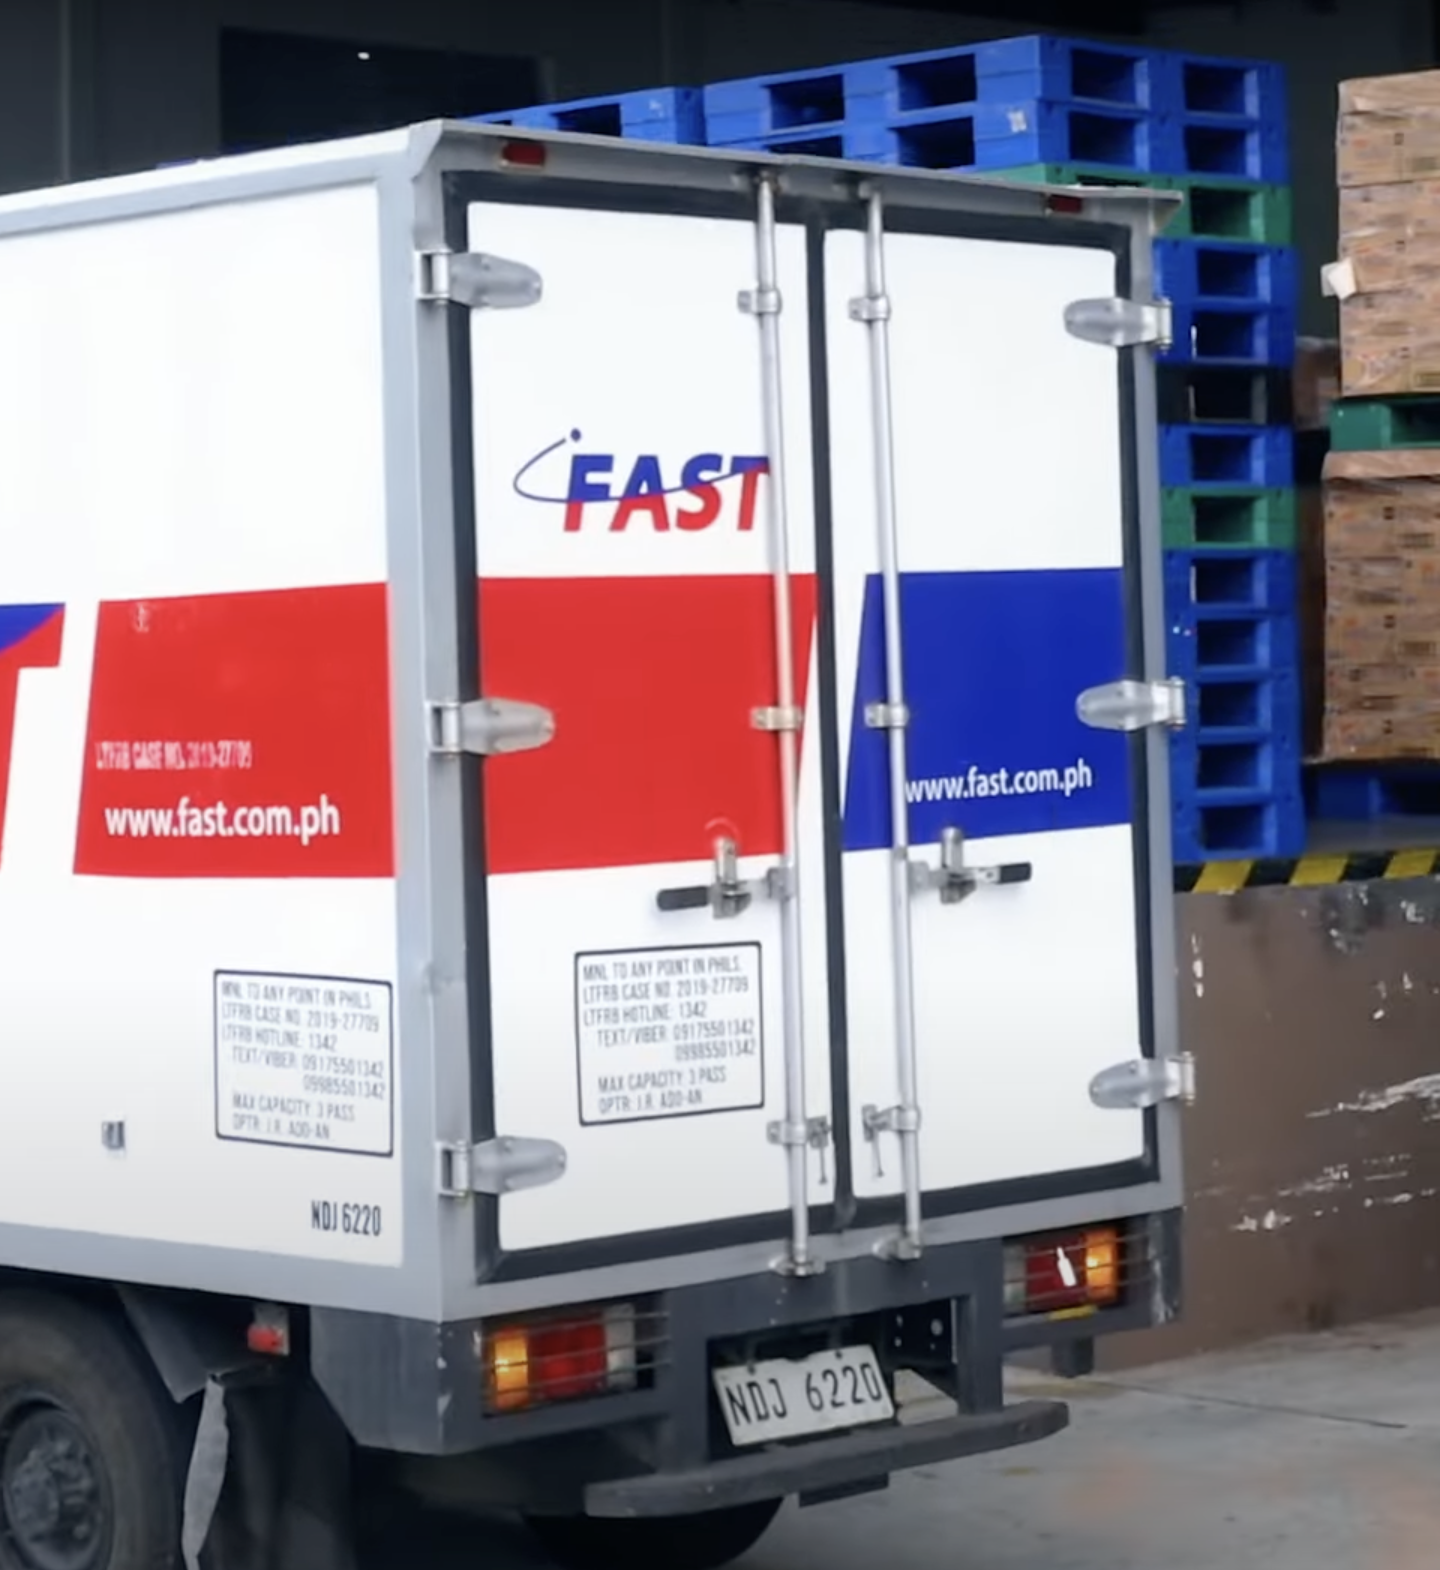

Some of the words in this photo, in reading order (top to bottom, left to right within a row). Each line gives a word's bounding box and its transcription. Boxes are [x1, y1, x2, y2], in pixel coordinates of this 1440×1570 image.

[563, 453, 771, 532] FAST
[905, 758, 1092, 803] www.fast.com.ph
[105, 793, 340, 846] www.fast.com.ph
[583, 963, 607, 981] MNL
[613, 962, 627, 979] TO
[631, 961, 652, 978] ANY
[657, 958, 689, 976] POINT
[693, 957, 705, 973] IN
[247, 982, 260, 999] TO
[263, 985, 284, 1001] ANY
[288, 987, 320, 1004] POINT
[324, 990, 336, 1006] IN
[583, 984, 618, 1004] LTFRB
[622, 982, 650, 1000] CASE
[222, 1002, 252, 1020] LTFRB
[255, 1004, 281, 1024] CASE
[307, 1010, 379, 1032] 2019-27709
[584, 1007, 620, 1026] LTFRB
[679, 1001, 707, 1018] 1342
[222, 1024, 252, 1042] LTFRB
[308, 1033, 337, 1051] 1342
[598, 1076, 623, 1093] MAX
[699, 1065, 727, 1083] PASS
[233, 1092, 255, 1110] MAX
[327, 1104, 355, 1122] PASS
[311, 1199, 337, 1232] NDJ
[342, 1202, 381, 1237] 6220
[725, 1378, 787, 1426] NDJ
[805, 1362, 882, 1411] 6220
